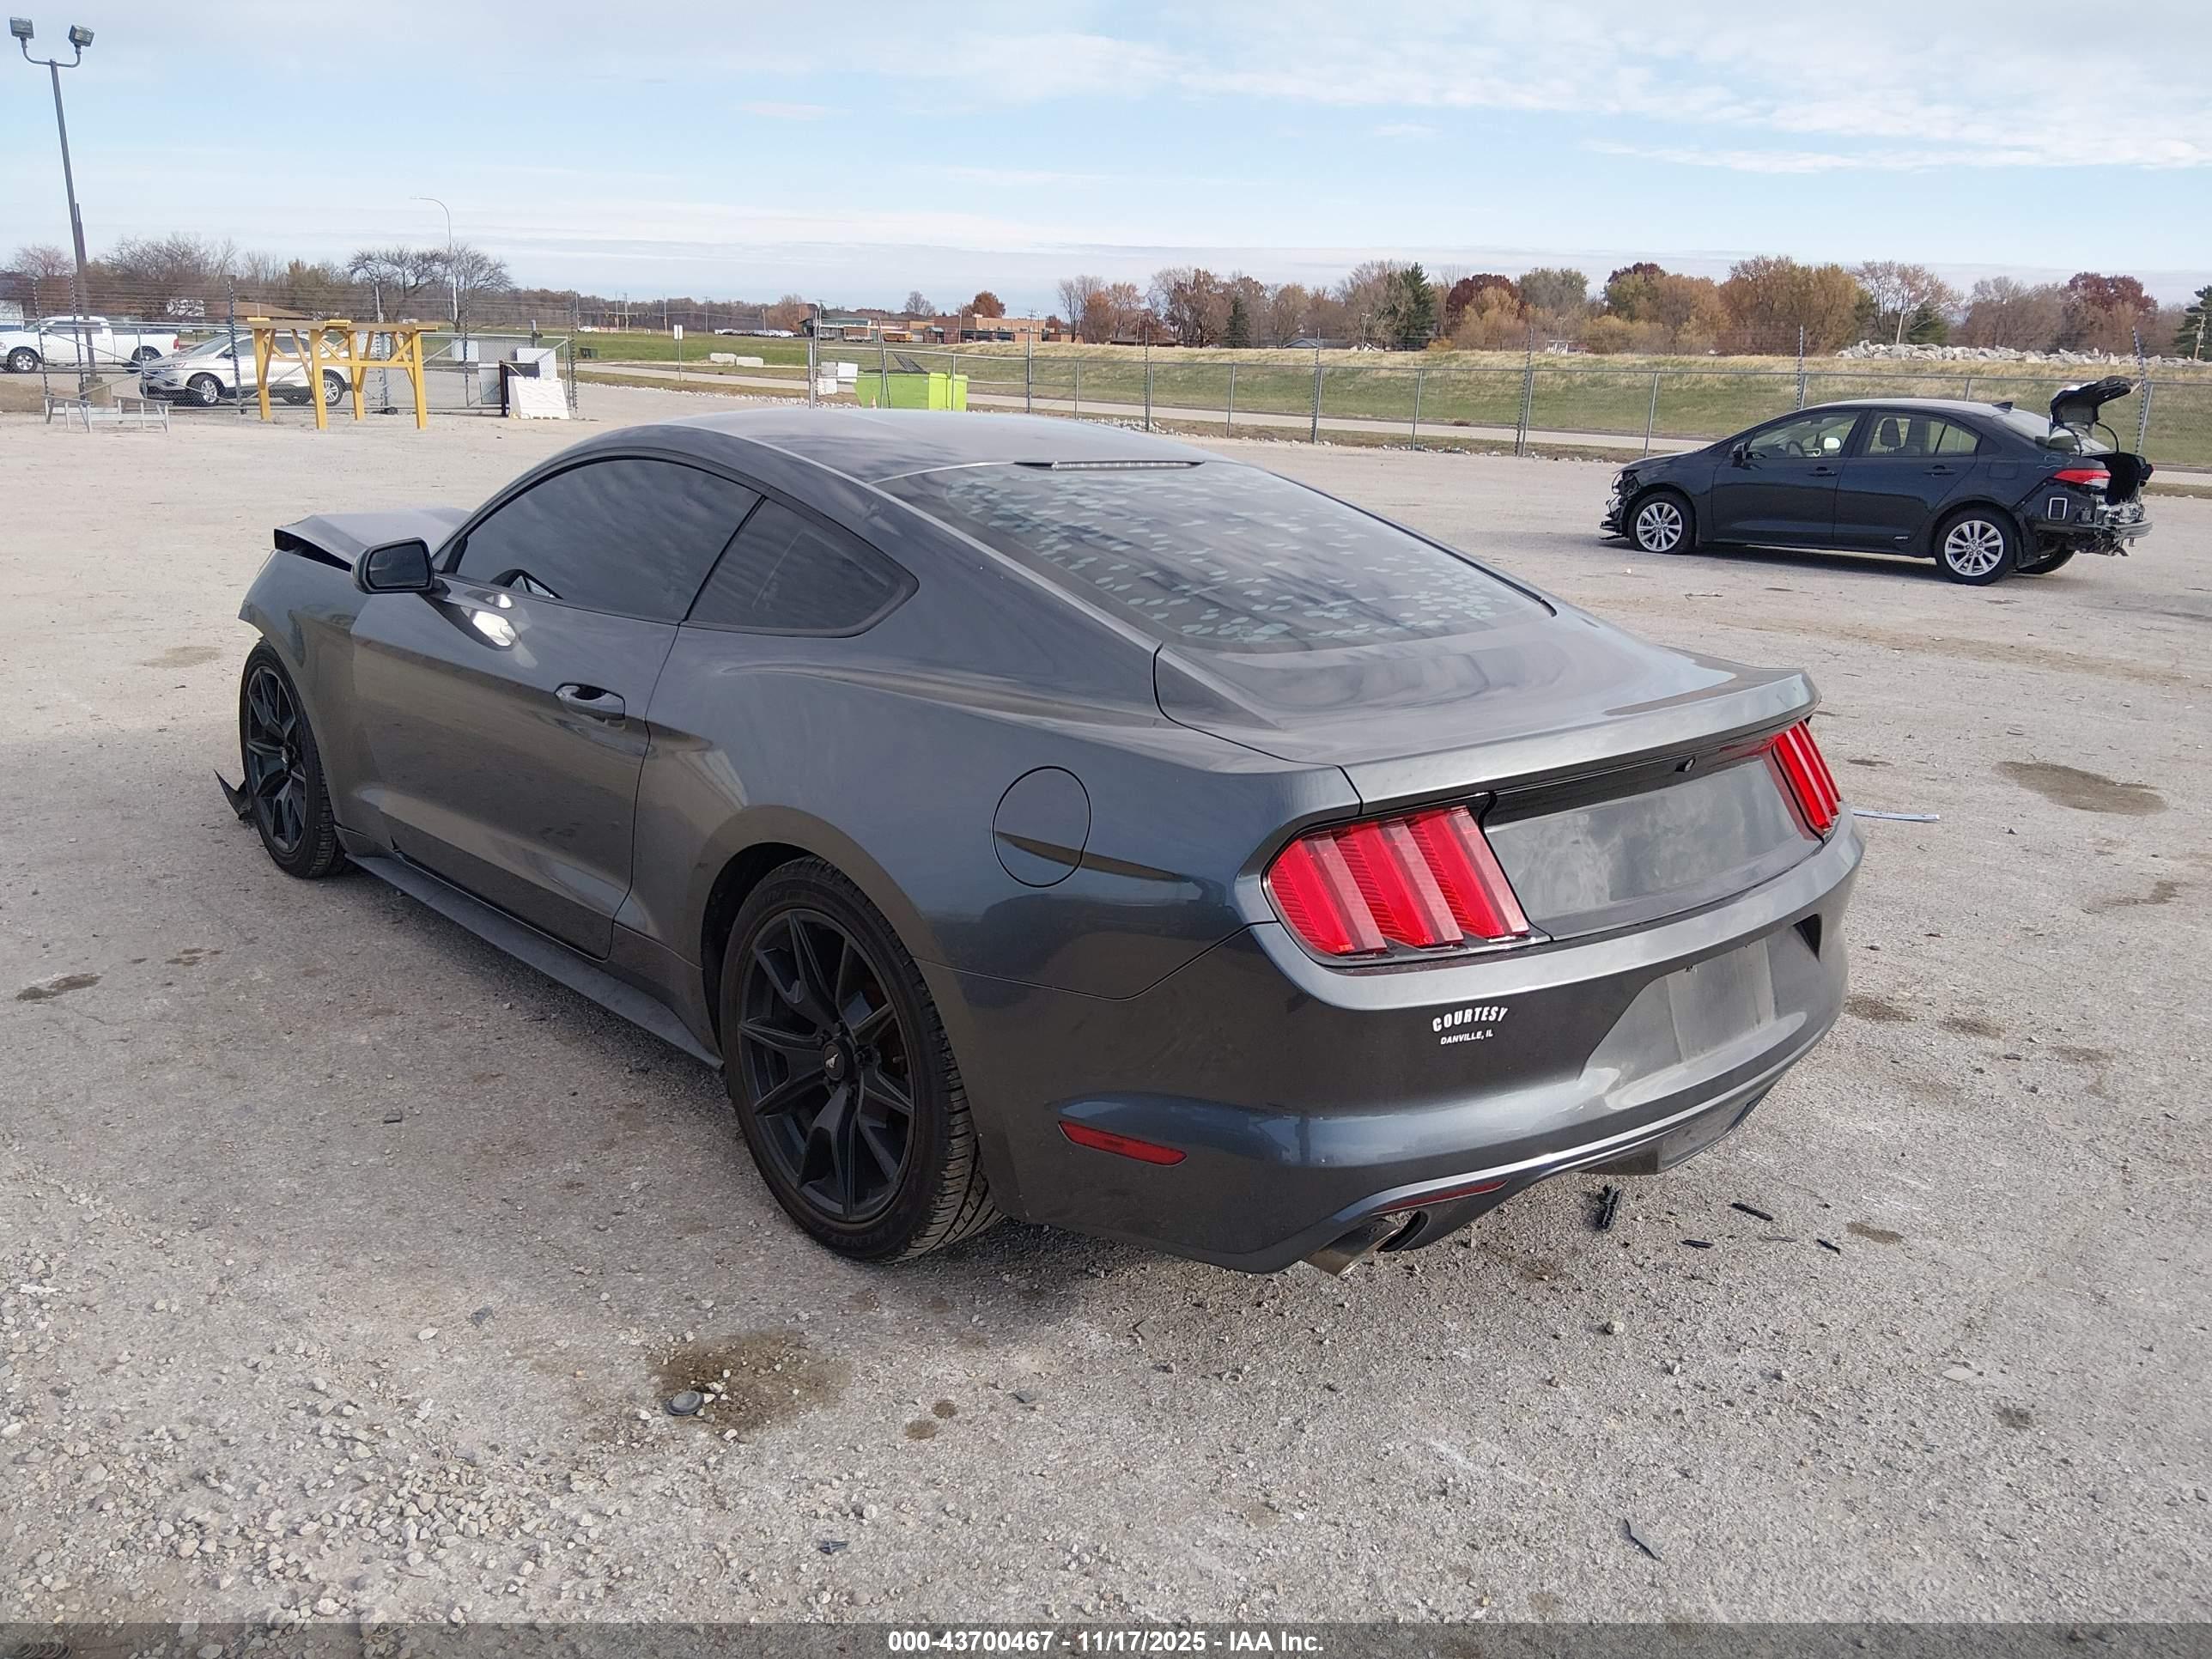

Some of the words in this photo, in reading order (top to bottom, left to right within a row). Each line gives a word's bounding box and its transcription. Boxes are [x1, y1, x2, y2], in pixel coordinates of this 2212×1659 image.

[1432, 1006, 1508, 1032] COURTESY
[1440, 1030, 1485, 1045] DANVILLE,
[1486, 1029, 1493, 1037] IL
